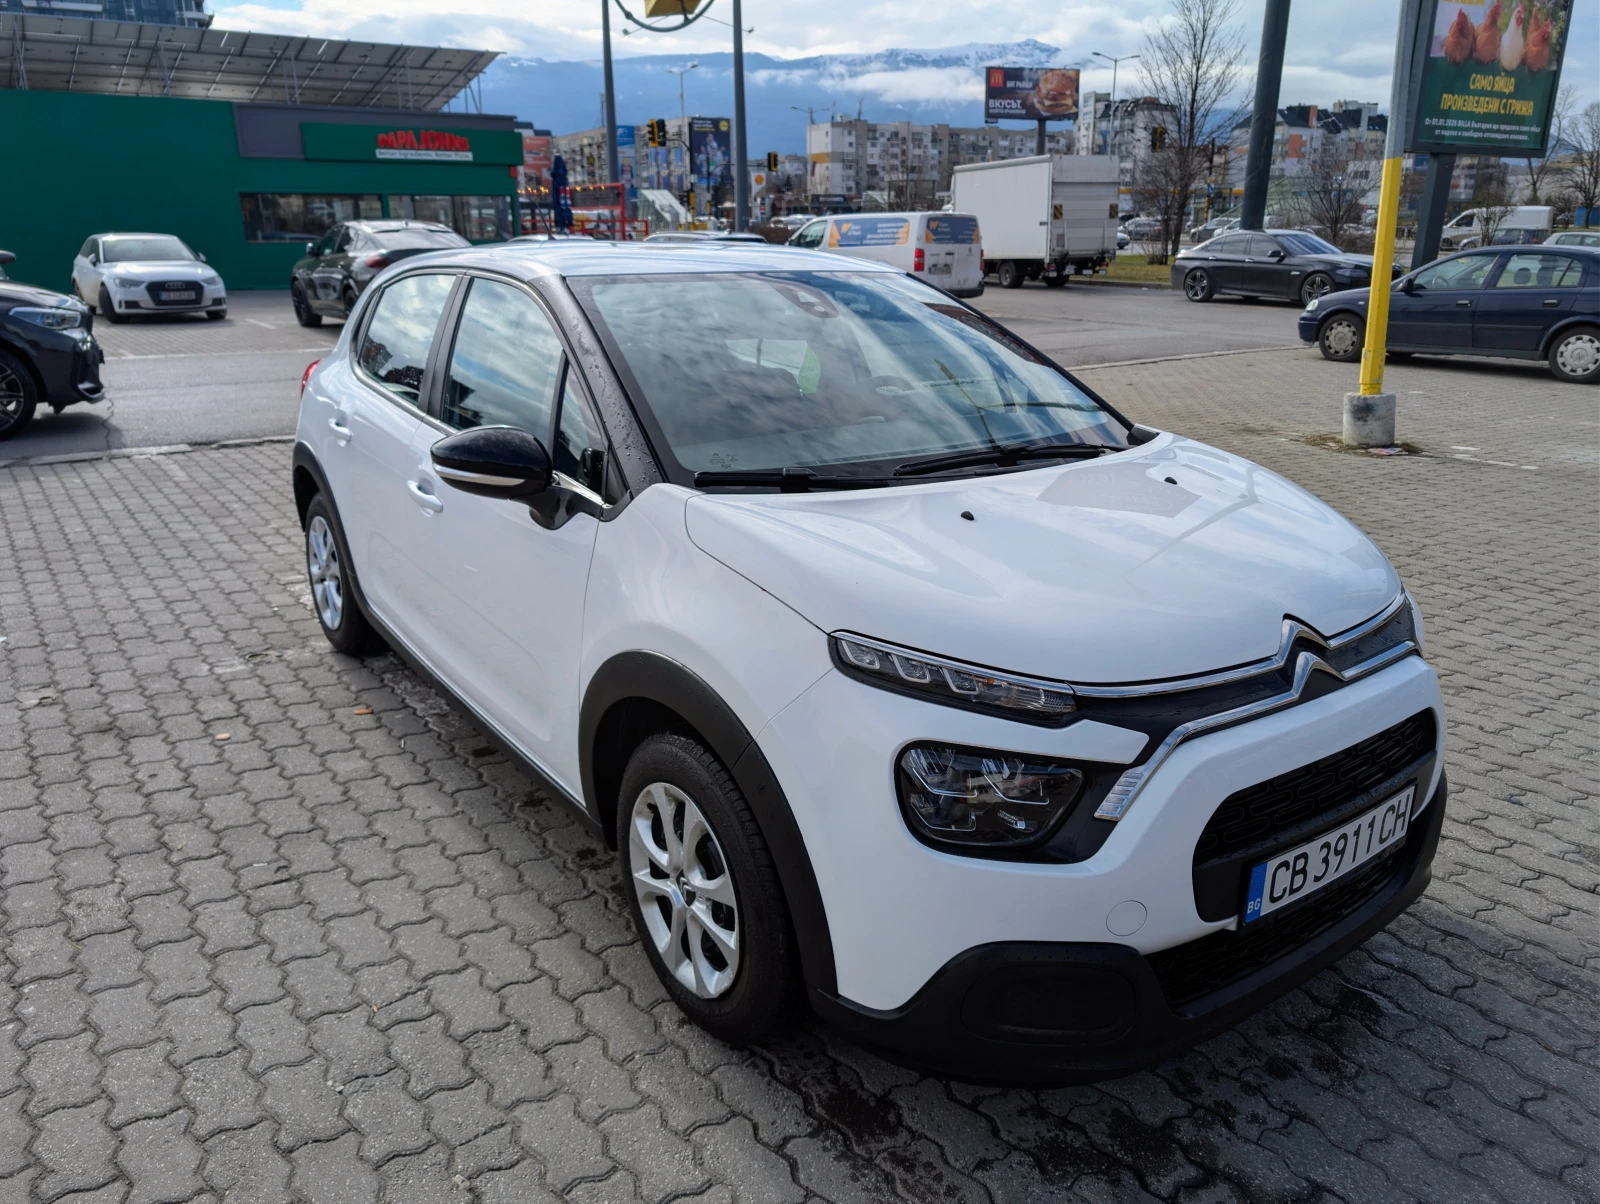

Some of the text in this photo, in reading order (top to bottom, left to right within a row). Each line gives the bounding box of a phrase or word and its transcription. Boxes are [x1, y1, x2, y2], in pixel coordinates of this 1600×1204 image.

[1470, 72, 1515, 95] САМО ЯЙЦА
[1441, 94, 1534, 117] ПРОИЗВЕДЕНИ С ГРИЖА
[1458, 119, 1471, 128] BILLA
[378, 130, 418, 149] PAPA
[1312, 816, 1376, 883] 3911
[1246, 897, 1262, 915] BG
